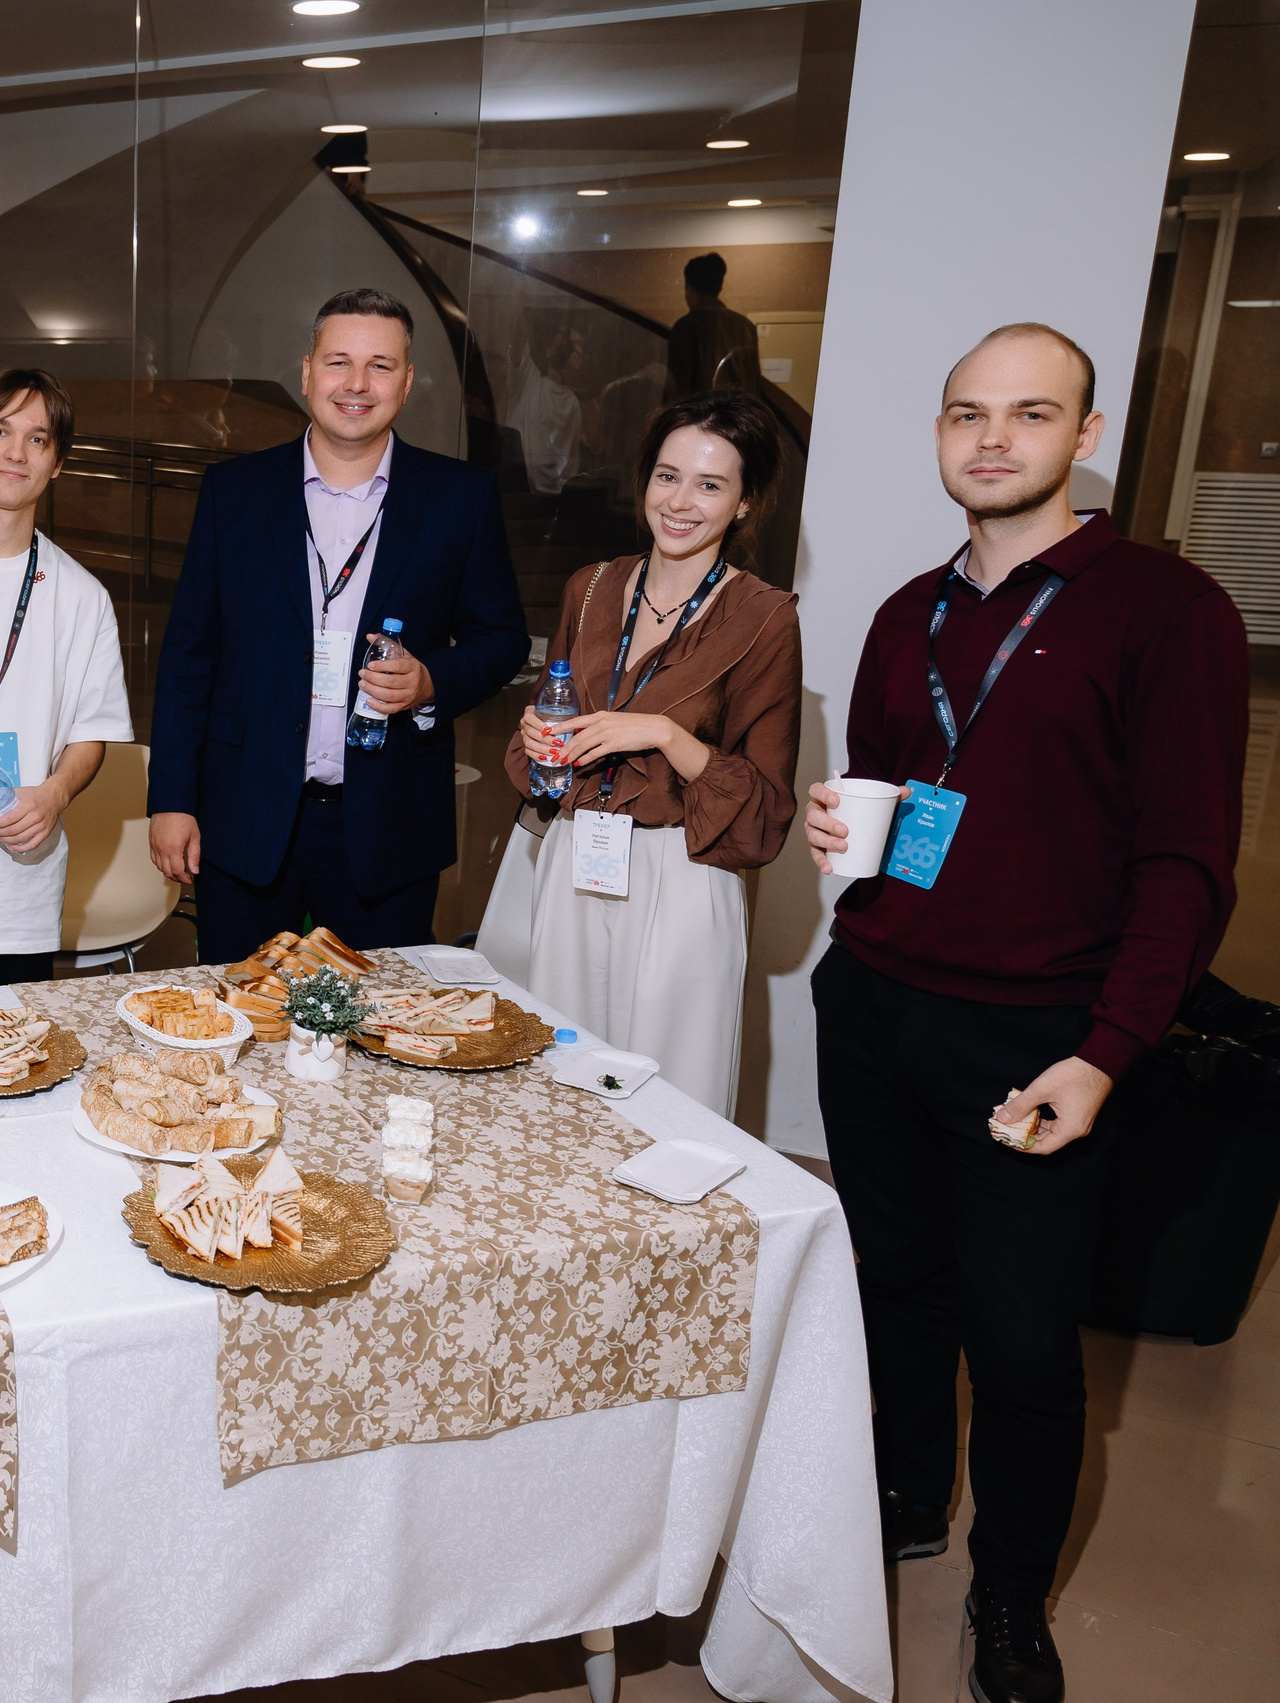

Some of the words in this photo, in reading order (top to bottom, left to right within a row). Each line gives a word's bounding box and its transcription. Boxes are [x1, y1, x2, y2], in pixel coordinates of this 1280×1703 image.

[21, 578, 31, 606] СЕГОДНЯ
[1030, 587, 1054, 616] FINOPOLIS
[936, 600, 947, 612] 365
[1020, 614, 1034, 628] 365
[313, 668, 339, 691] 65
[937, 701, 954, 737] СЕГОДНЯ
[918, 797, 947, 811] УЧАСТНИК
[917, 818, 935, 828] Крылов
[922, 812, 934, 820] Иван
[894, 834, 940, 869] 365
[580, 853, 620, 879] 365
